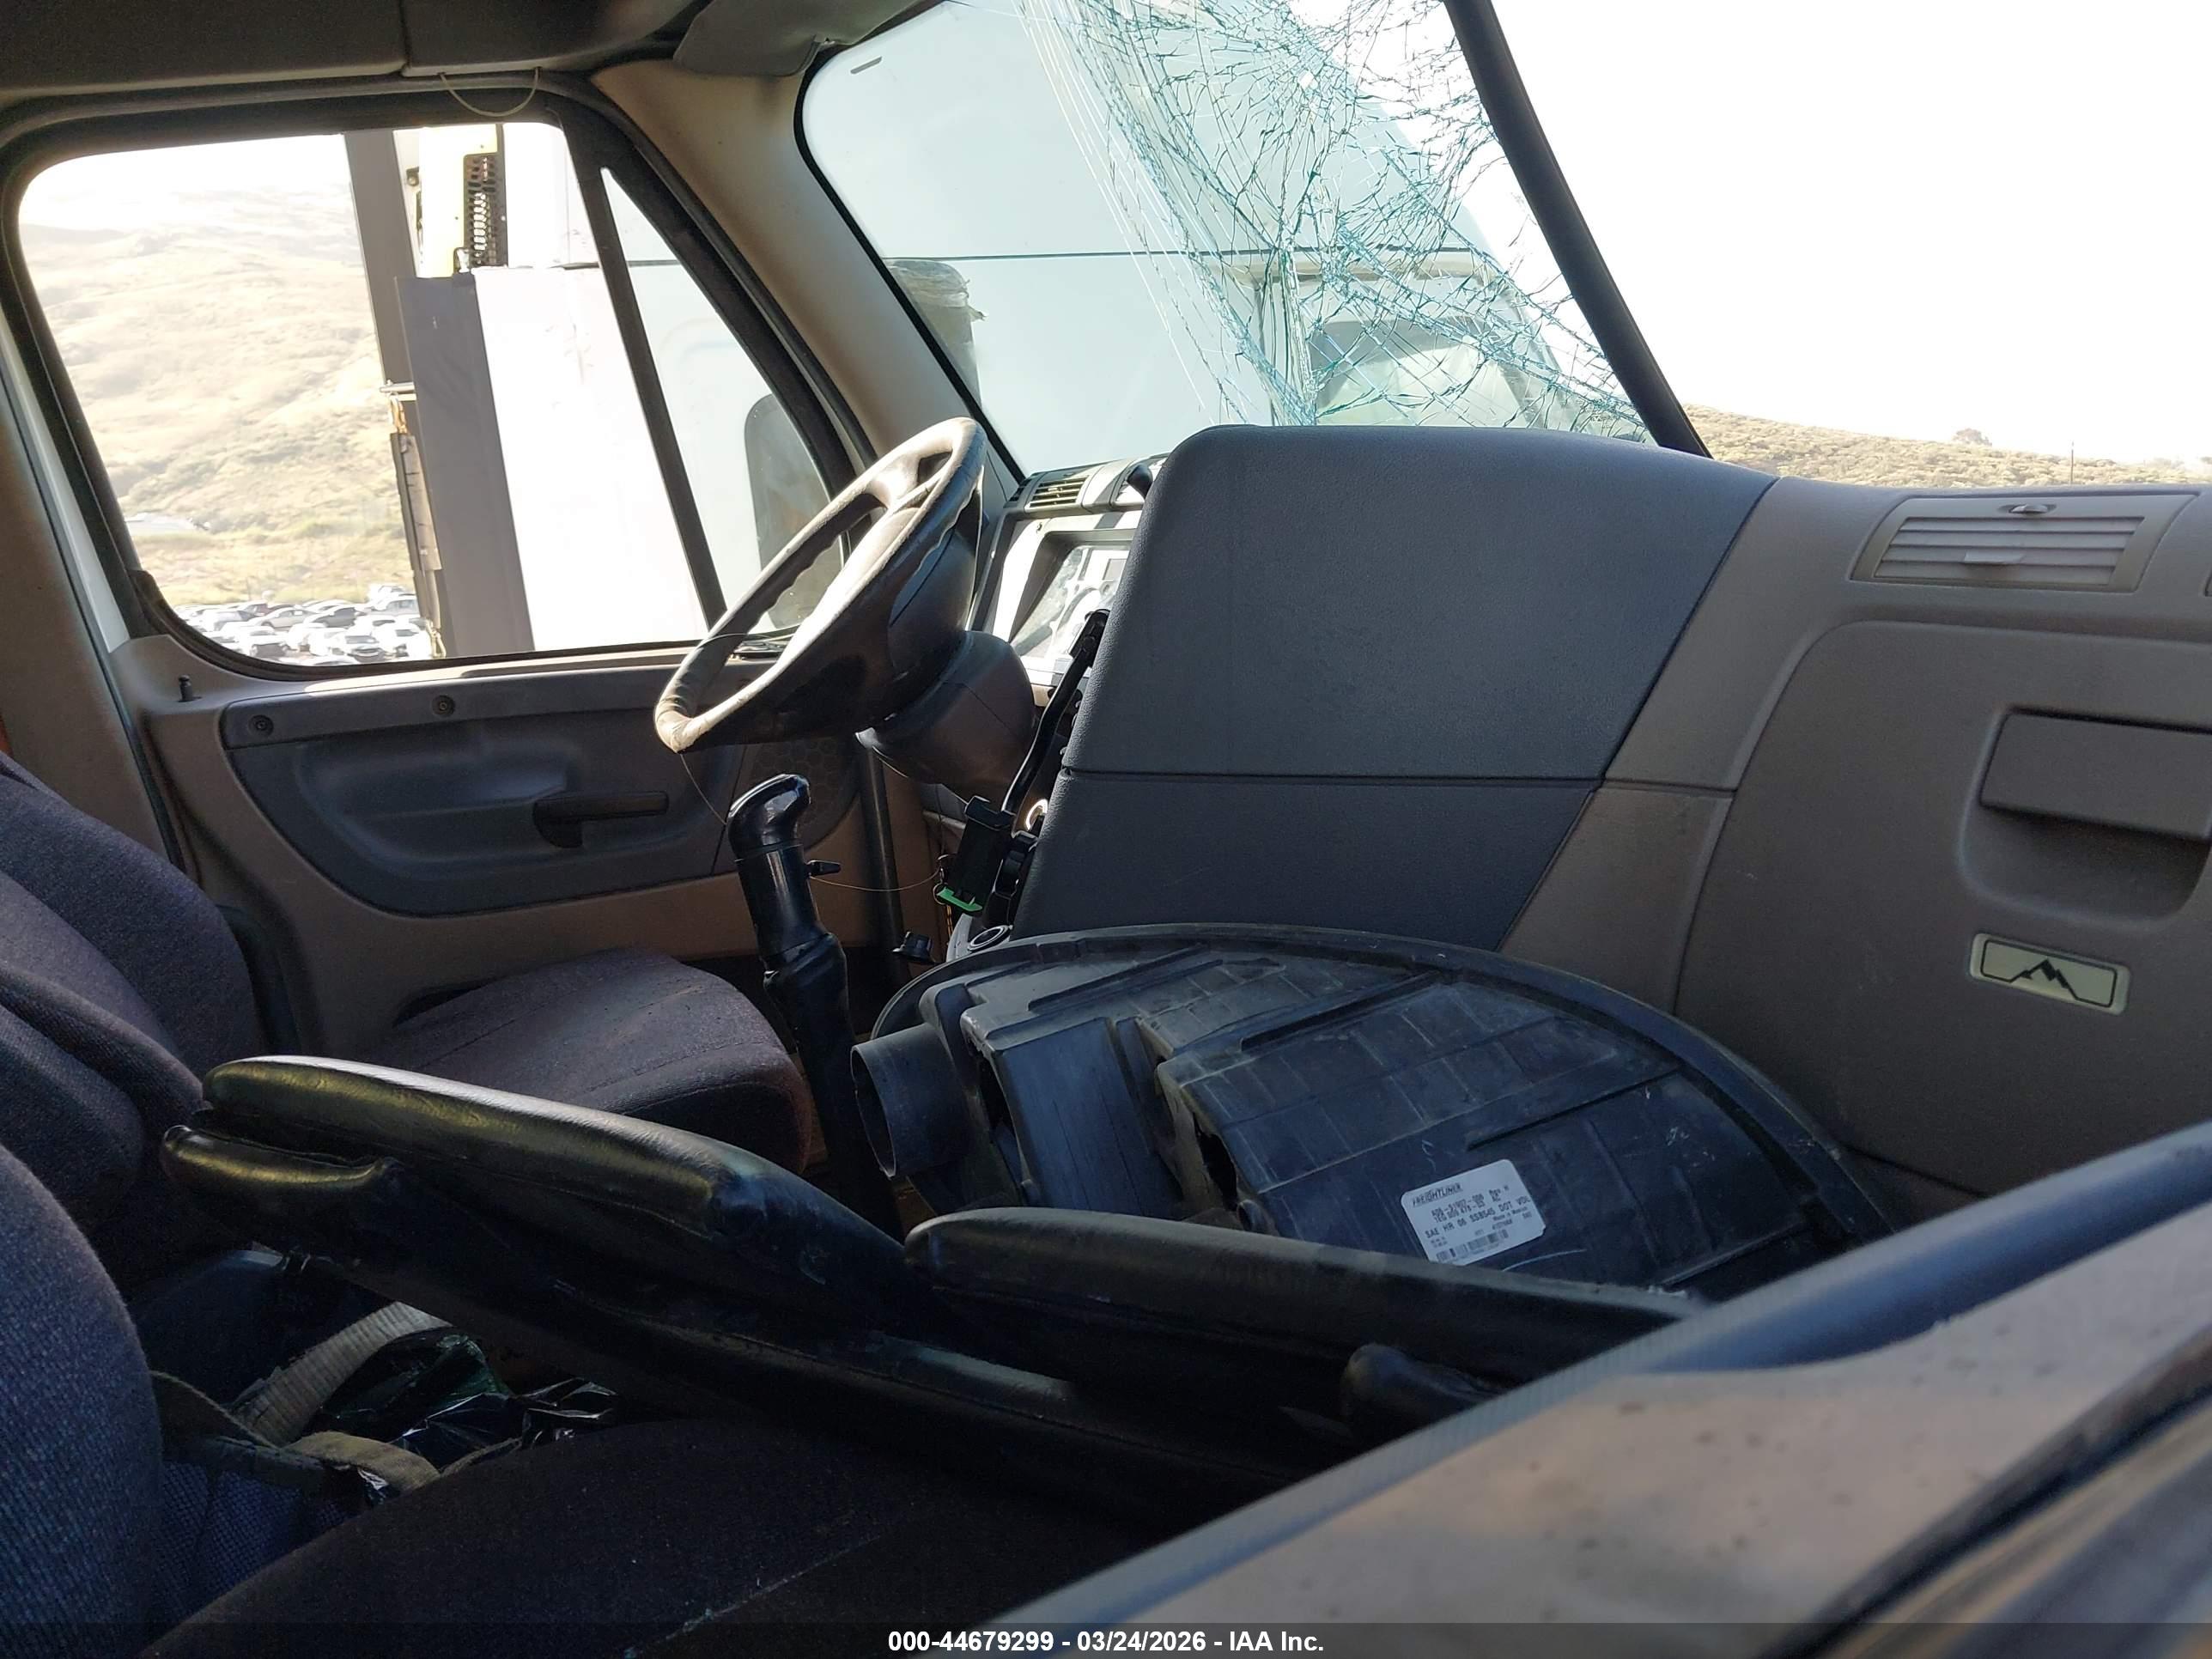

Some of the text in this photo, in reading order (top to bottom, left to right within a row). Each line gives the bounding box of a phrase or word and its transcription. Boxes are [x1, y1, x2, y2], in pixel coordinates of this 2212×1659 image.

[1412, 1182, 1462, 1206] FREIGHTLINER
[1425, 1228, 1439, 1238] SAE
[1443, 1222, 1455, 1231] HR
[1498, 1201, 1512, 1212] DOT
